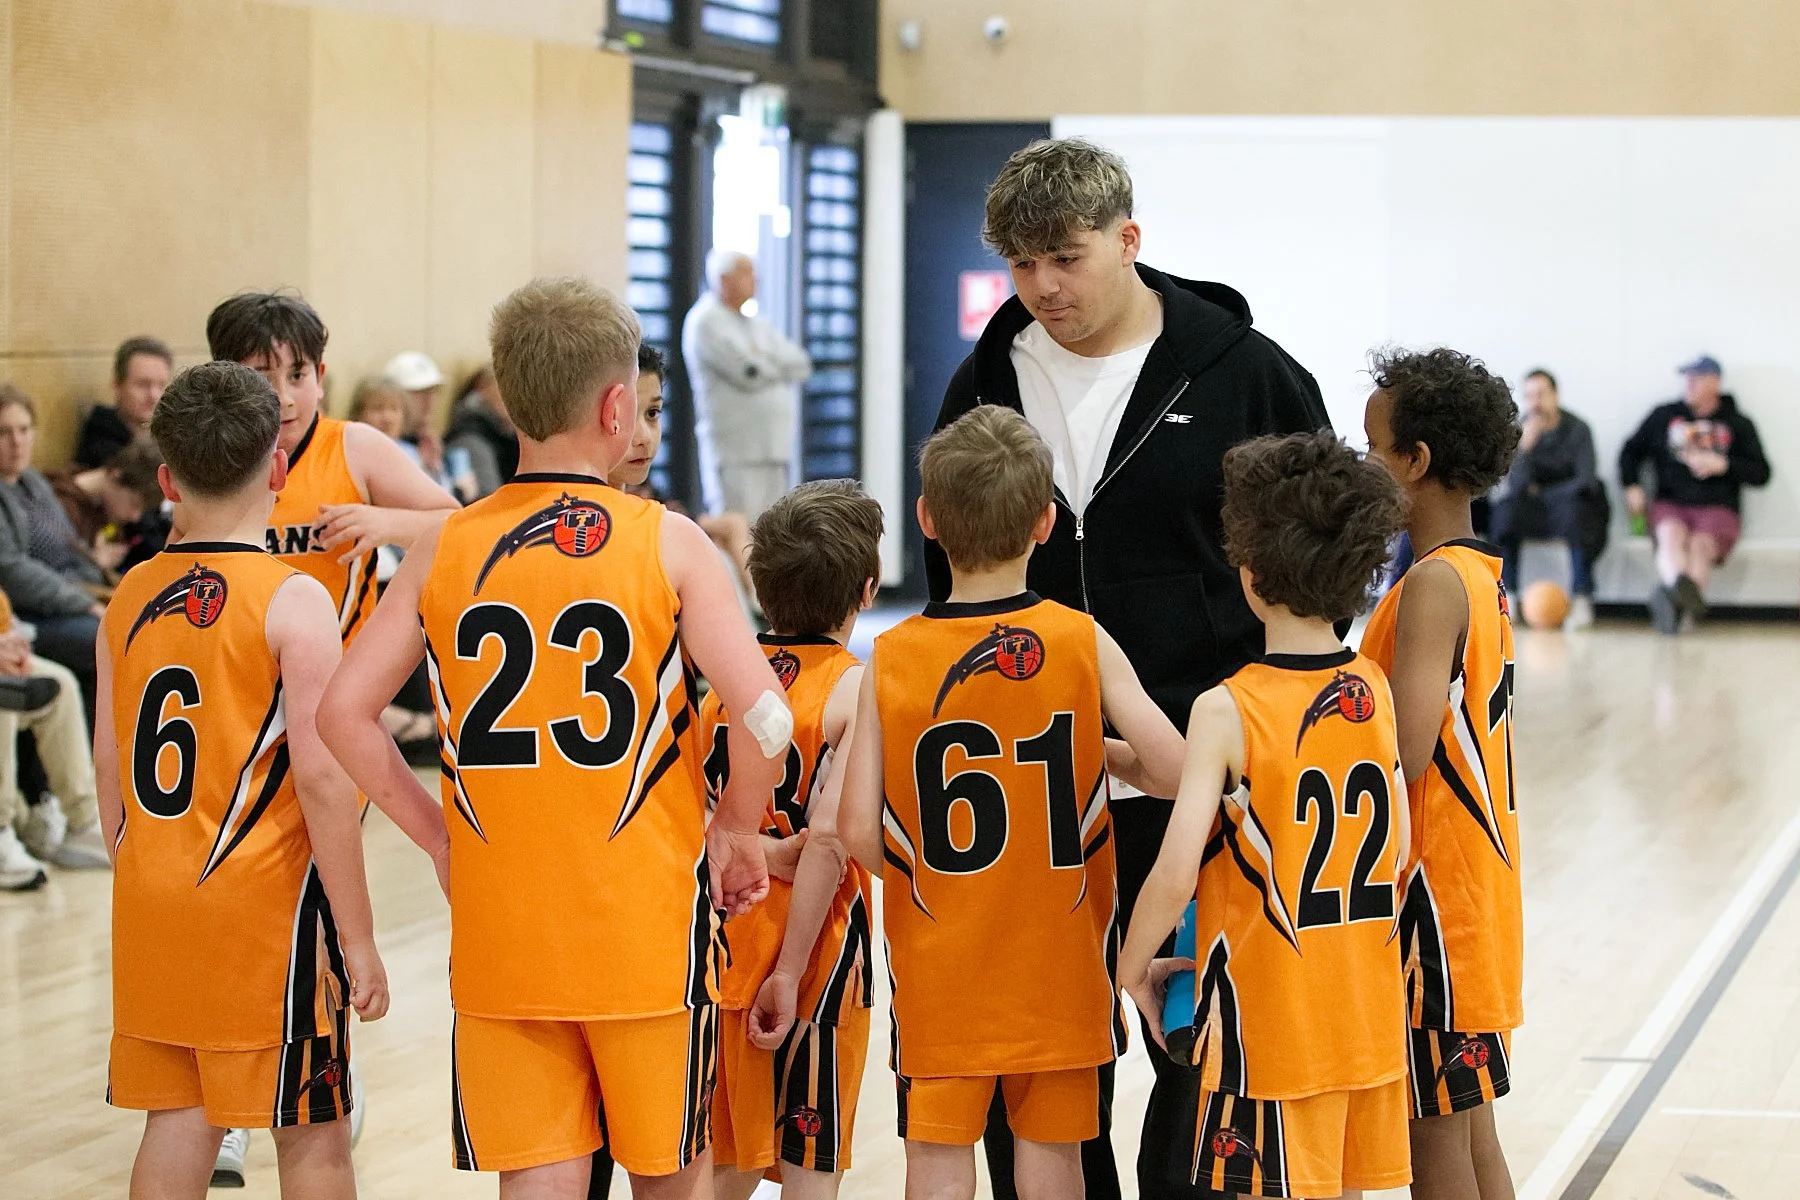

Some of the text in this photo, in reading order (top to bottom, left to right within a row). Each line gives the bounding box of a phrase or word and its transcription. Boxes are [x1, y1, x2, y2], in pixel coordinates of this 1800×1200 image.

[132, 664, 202, 819] 6
[455, 599, 638, 769] 23
[913, 711, 1085, 875] 61
[1294, 760, 1397, 931] 22
